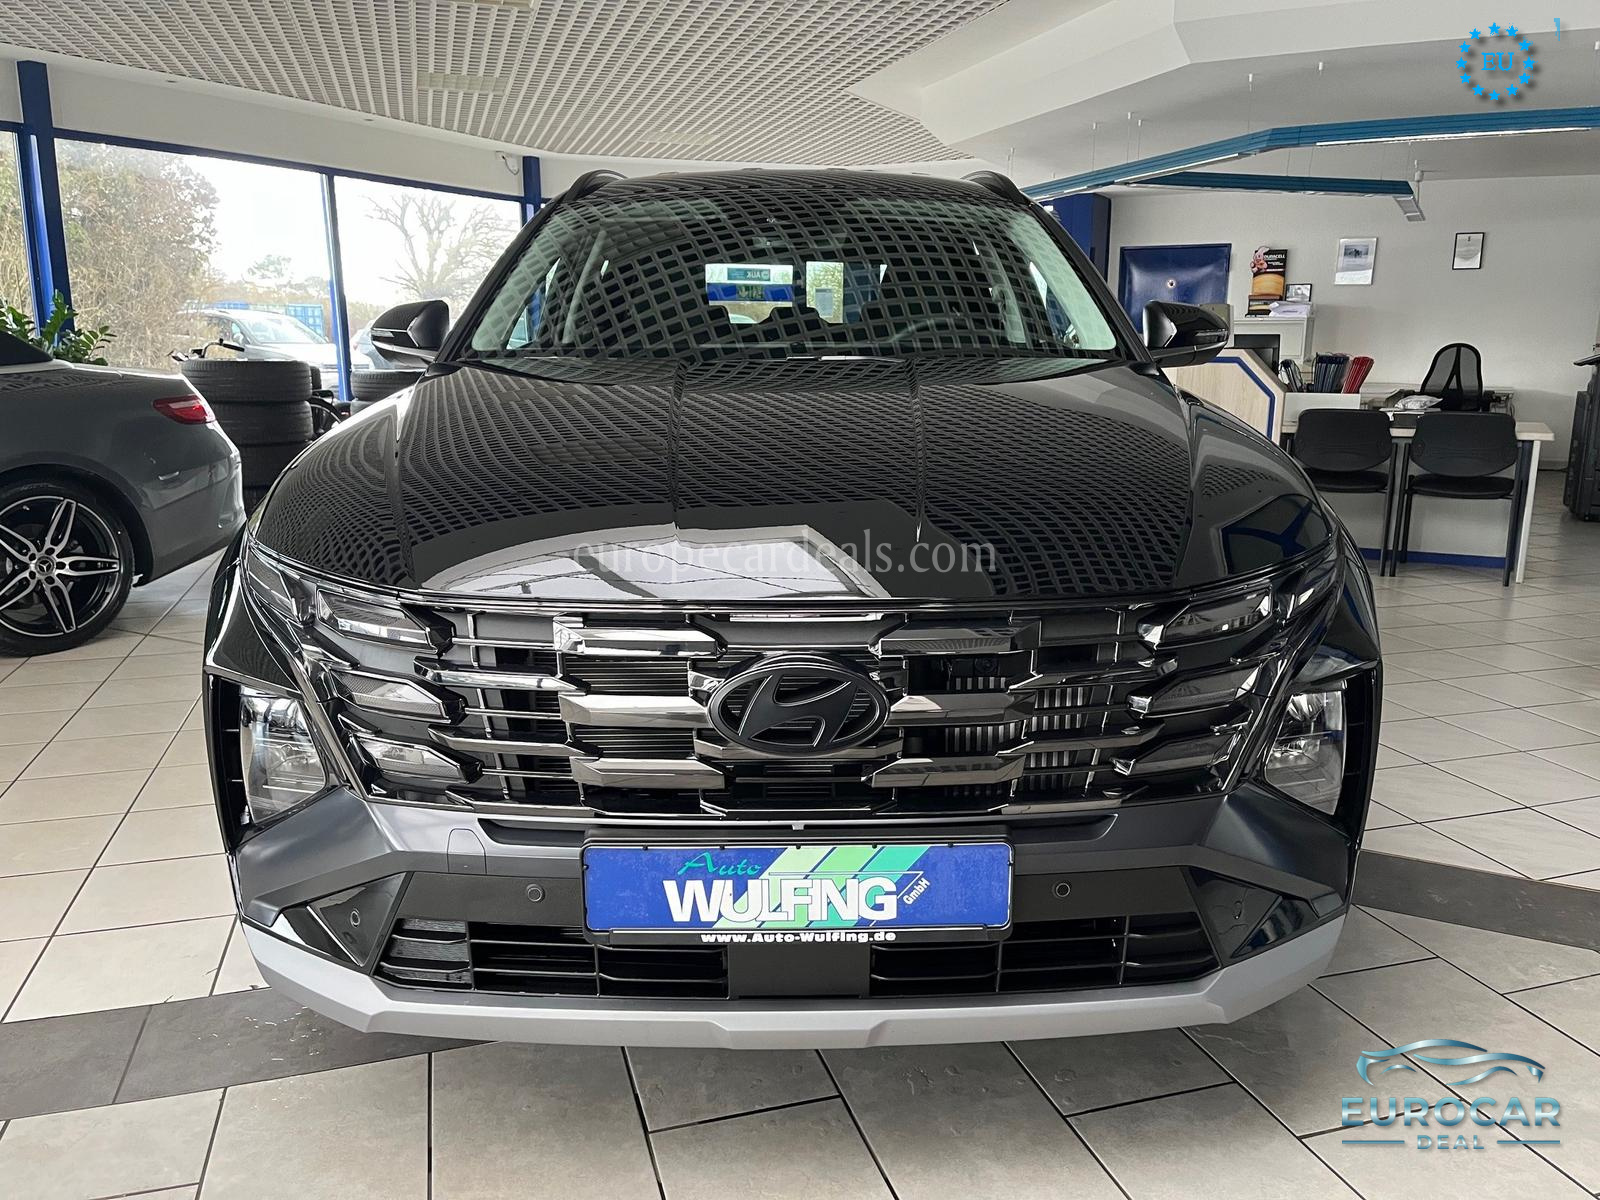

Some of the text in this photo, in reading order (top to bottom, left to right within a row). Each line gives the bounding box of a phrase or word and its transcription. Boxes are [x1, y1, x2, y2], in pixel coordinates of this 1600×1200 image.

[677, 851, 761, 876] Auto
[662, 876, 898, 923] WULFING
[903, 877, 930, 904] GmbH
[700, 931, 897, 943] www.Auto-Wulfing.de
